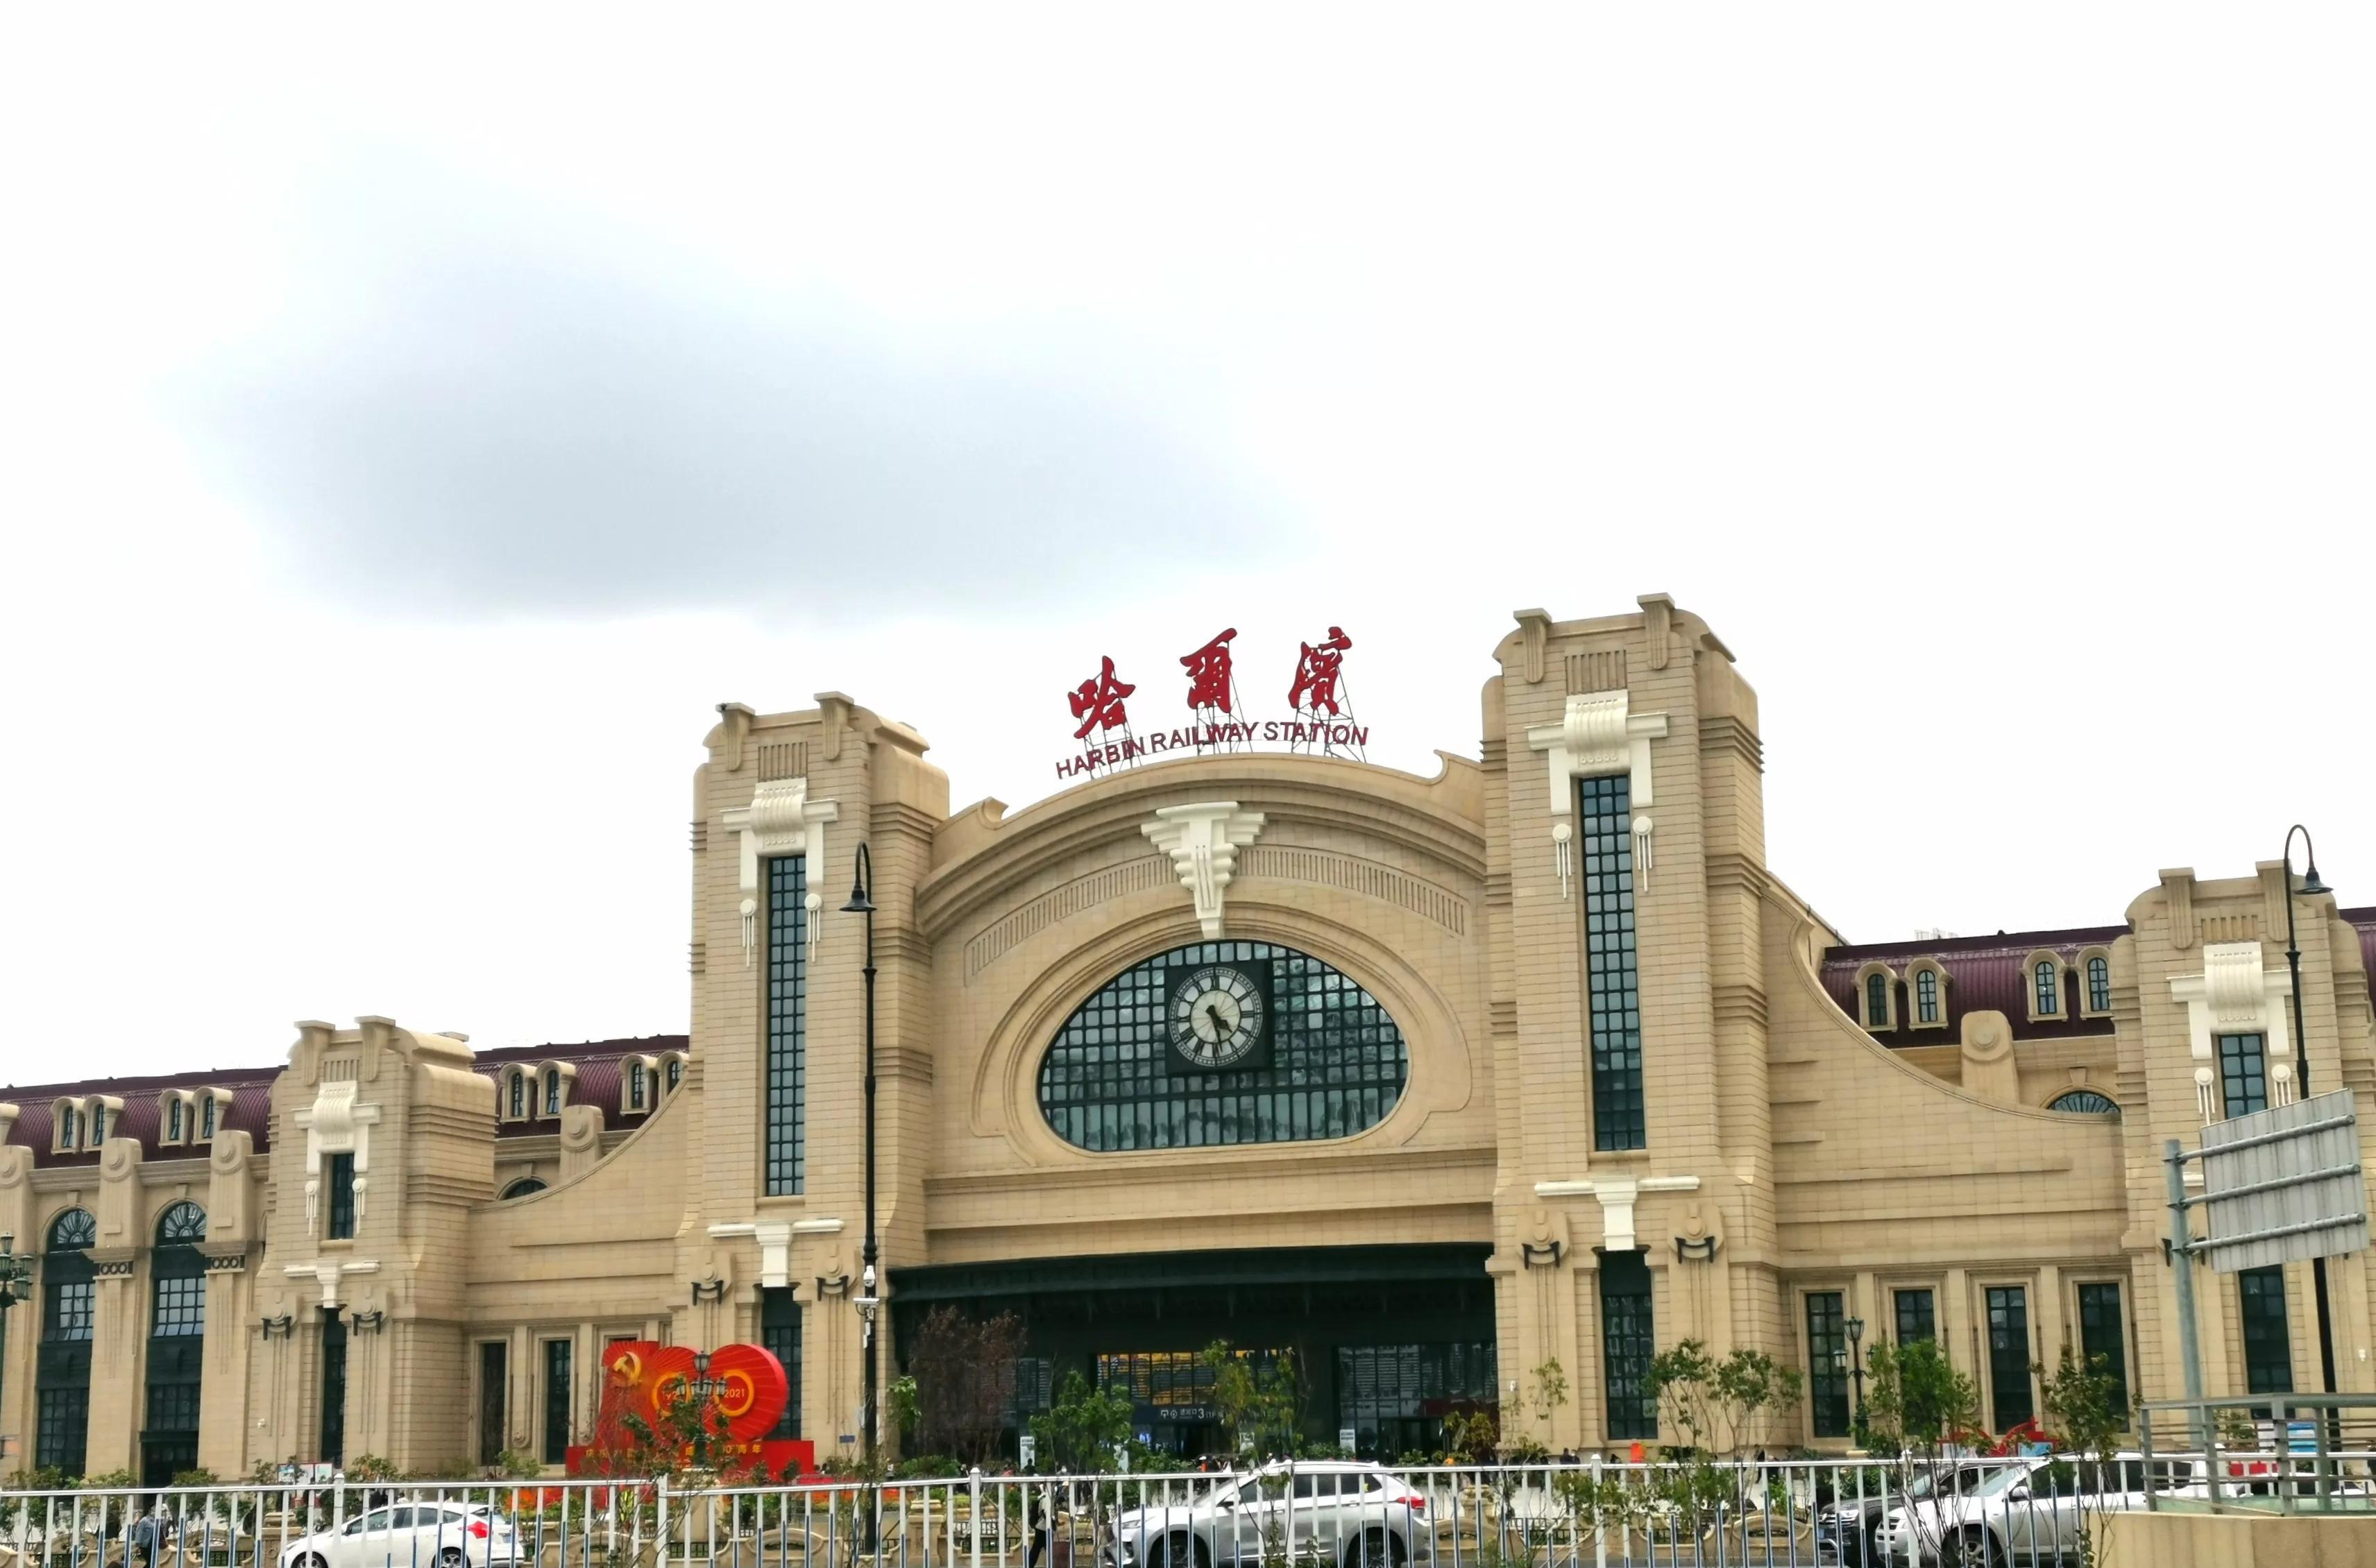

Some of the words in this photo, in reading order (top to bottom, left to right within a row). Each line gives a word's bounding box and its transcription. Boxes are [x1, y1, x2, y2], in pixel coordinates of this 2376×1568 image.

[1055, 736, 1146, 779] HARBIN
[1151, 722, 1260, 753] RAILWAY
[1263, 721, 1369, 746] STATION
[724, 1388, 745, 1398] 2021
[1198, 1408, 1205, 1419] 3
